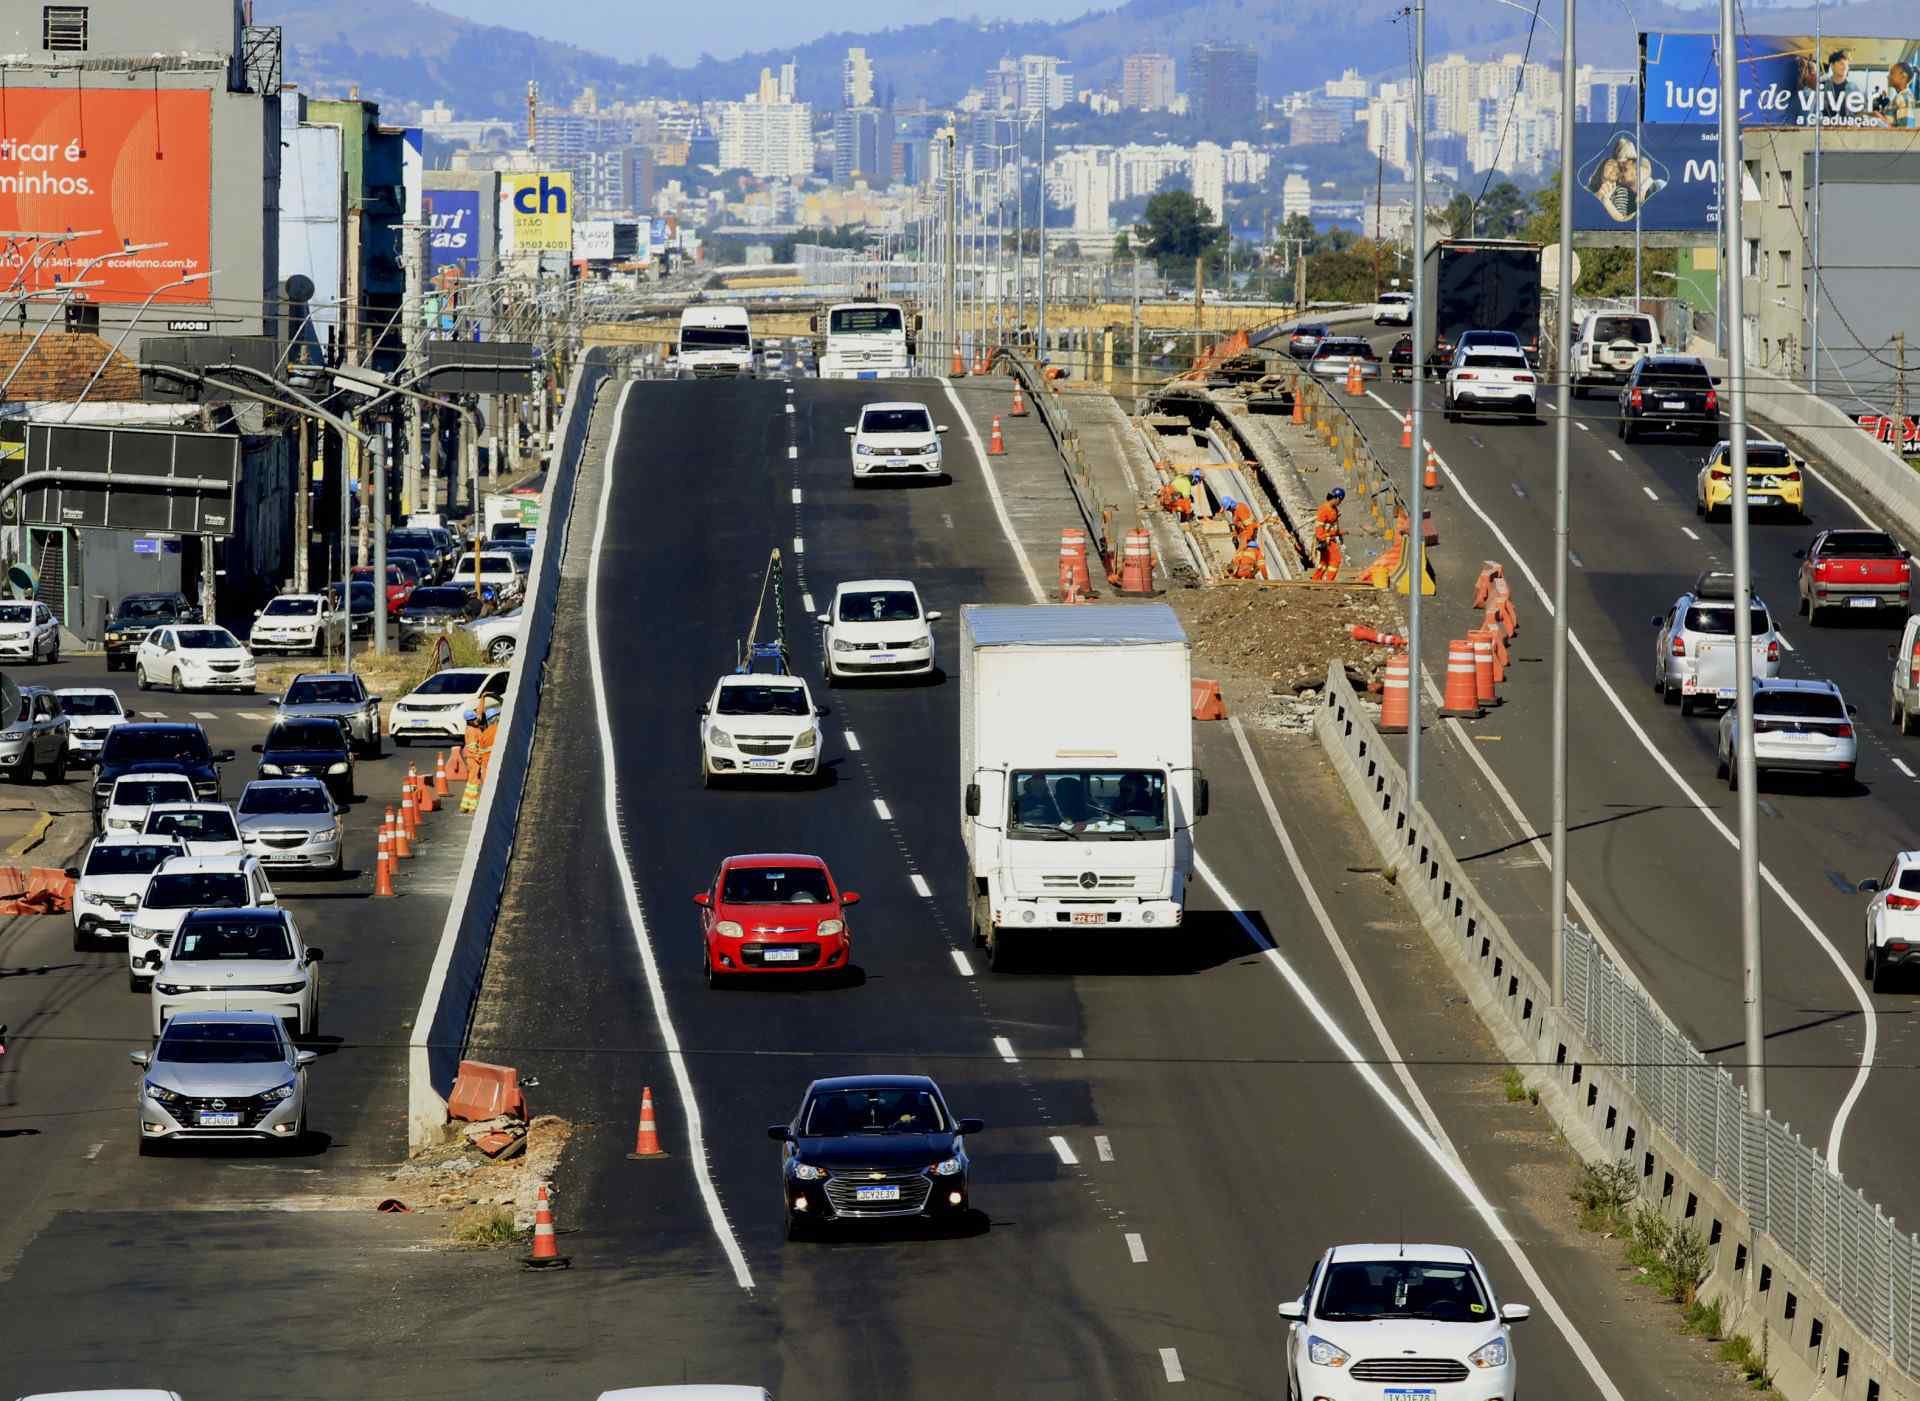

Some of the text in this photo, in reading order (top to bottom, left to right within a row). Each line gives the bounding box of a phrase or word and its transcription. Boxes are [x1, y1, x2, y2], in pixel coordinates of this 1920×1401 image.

[1665, 80, 1881, 115] lugr de viver
[64, 137, 80, 162] é
[0, 170, 95, 195] minhos.
[513, 176, 567, 214] ch
